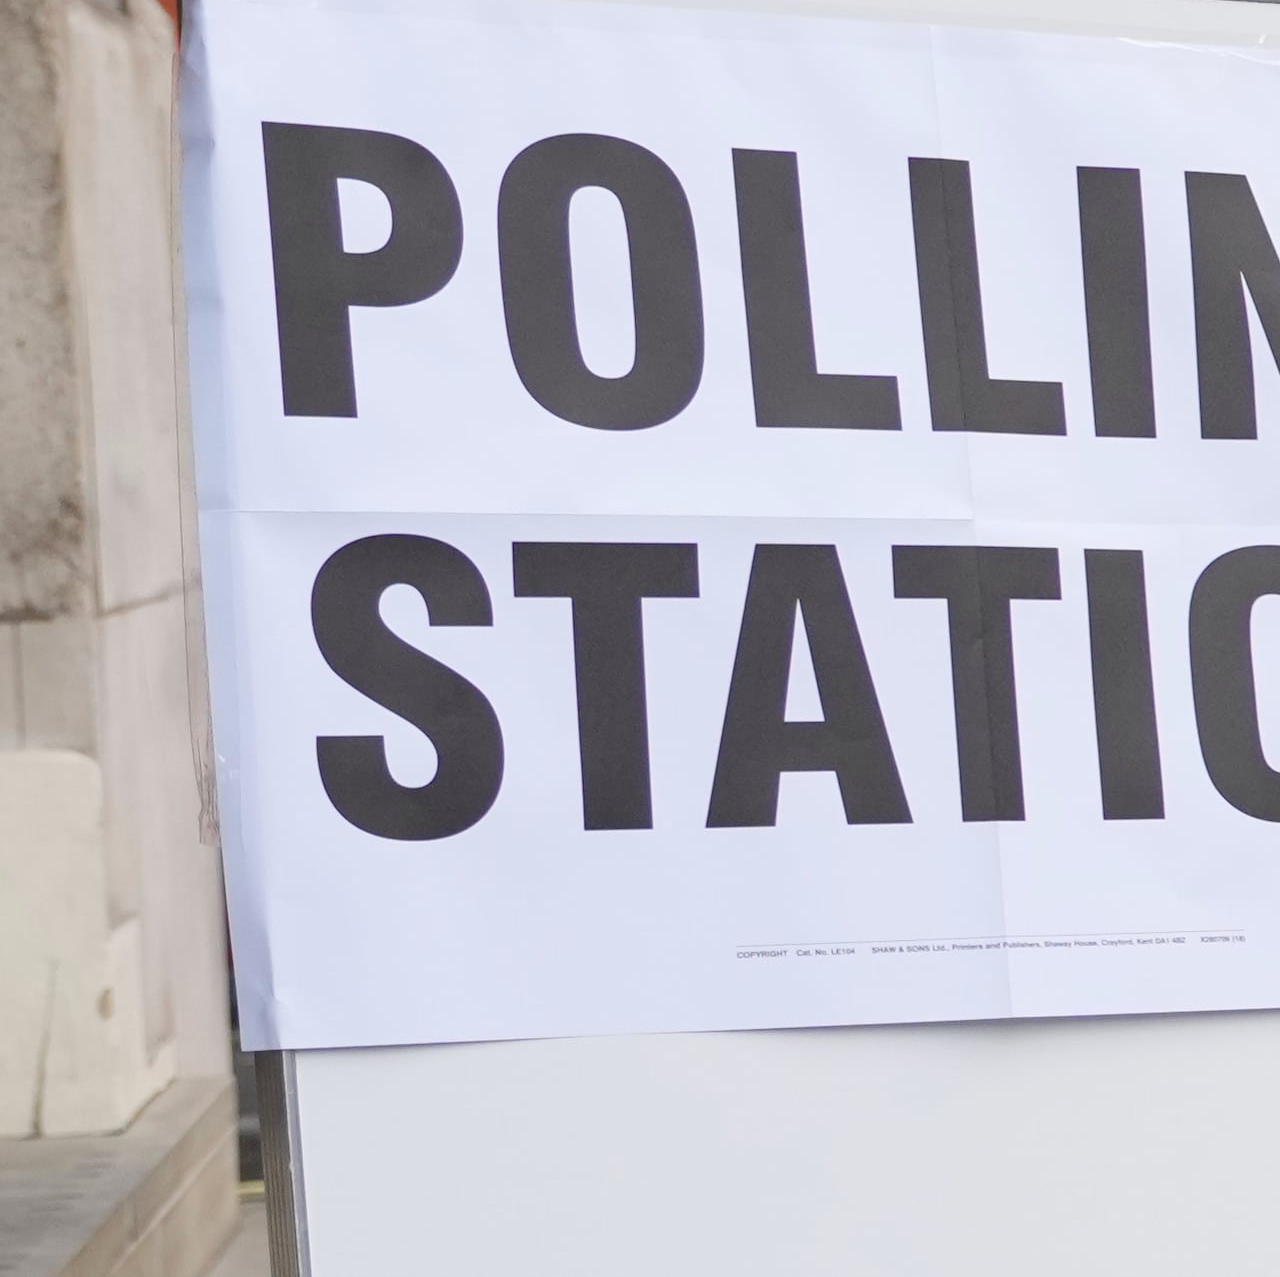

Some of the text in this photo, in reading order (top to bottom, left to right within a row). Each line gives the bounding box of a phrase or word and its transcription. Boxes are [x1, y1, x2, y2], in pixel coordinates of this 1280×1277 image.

[737, 950, 788, 959] COPYRIGHT
[796, 949, 812, 957] Cat.
[831, 948, 855, 956] LE104
[872, 946, 896, 954] SHAW
[899, 946, 905, 954] &
[906, 945, 930, 953] SONS
[952, 943, 984, 951] Printers
[1073, 940, 1099, 948] House,
[1101, 939, 1134, 947] Crayford,
